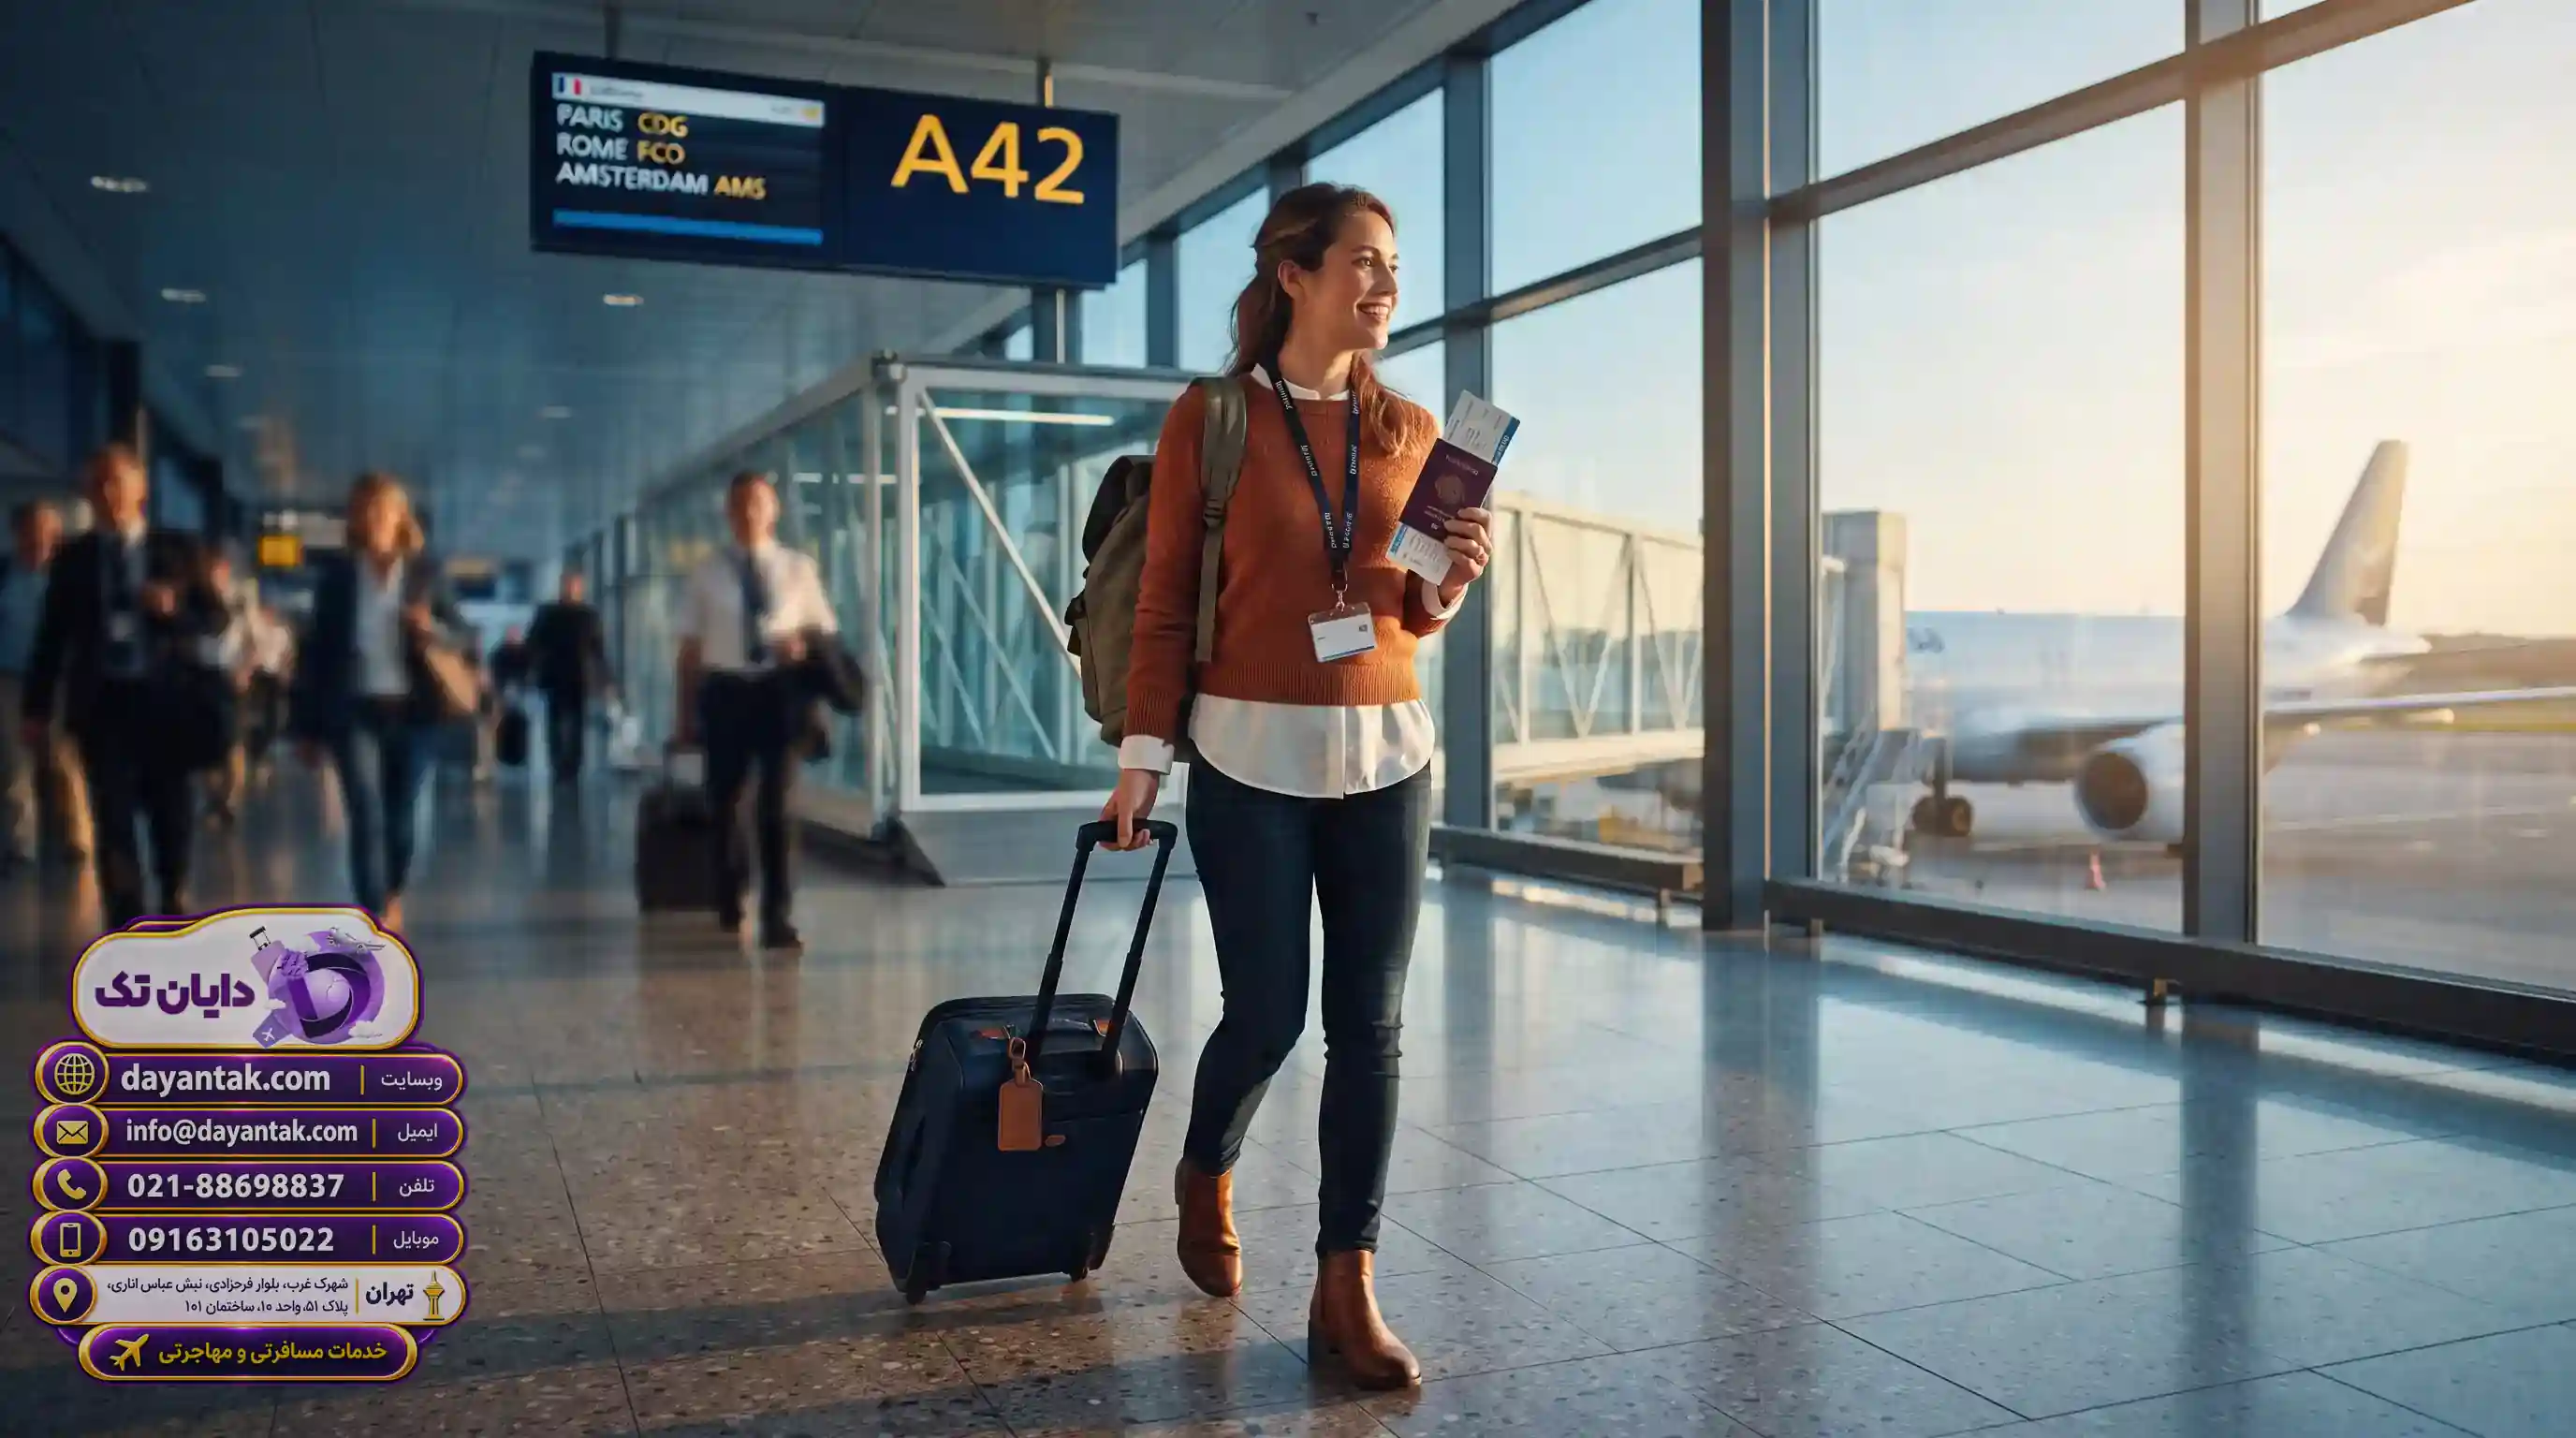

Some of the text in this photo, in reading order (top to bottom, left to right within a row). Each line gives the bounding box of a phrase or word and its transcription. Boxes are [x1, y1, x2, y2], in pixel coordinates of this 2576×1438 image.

[556, 102, 689, 138] PARIS CDG
[556, 132, 686, 165] ROME FCO
[890, 112, 1085, 205] A42
[555, 161, 767, 200] AMSTERDAM AMS
